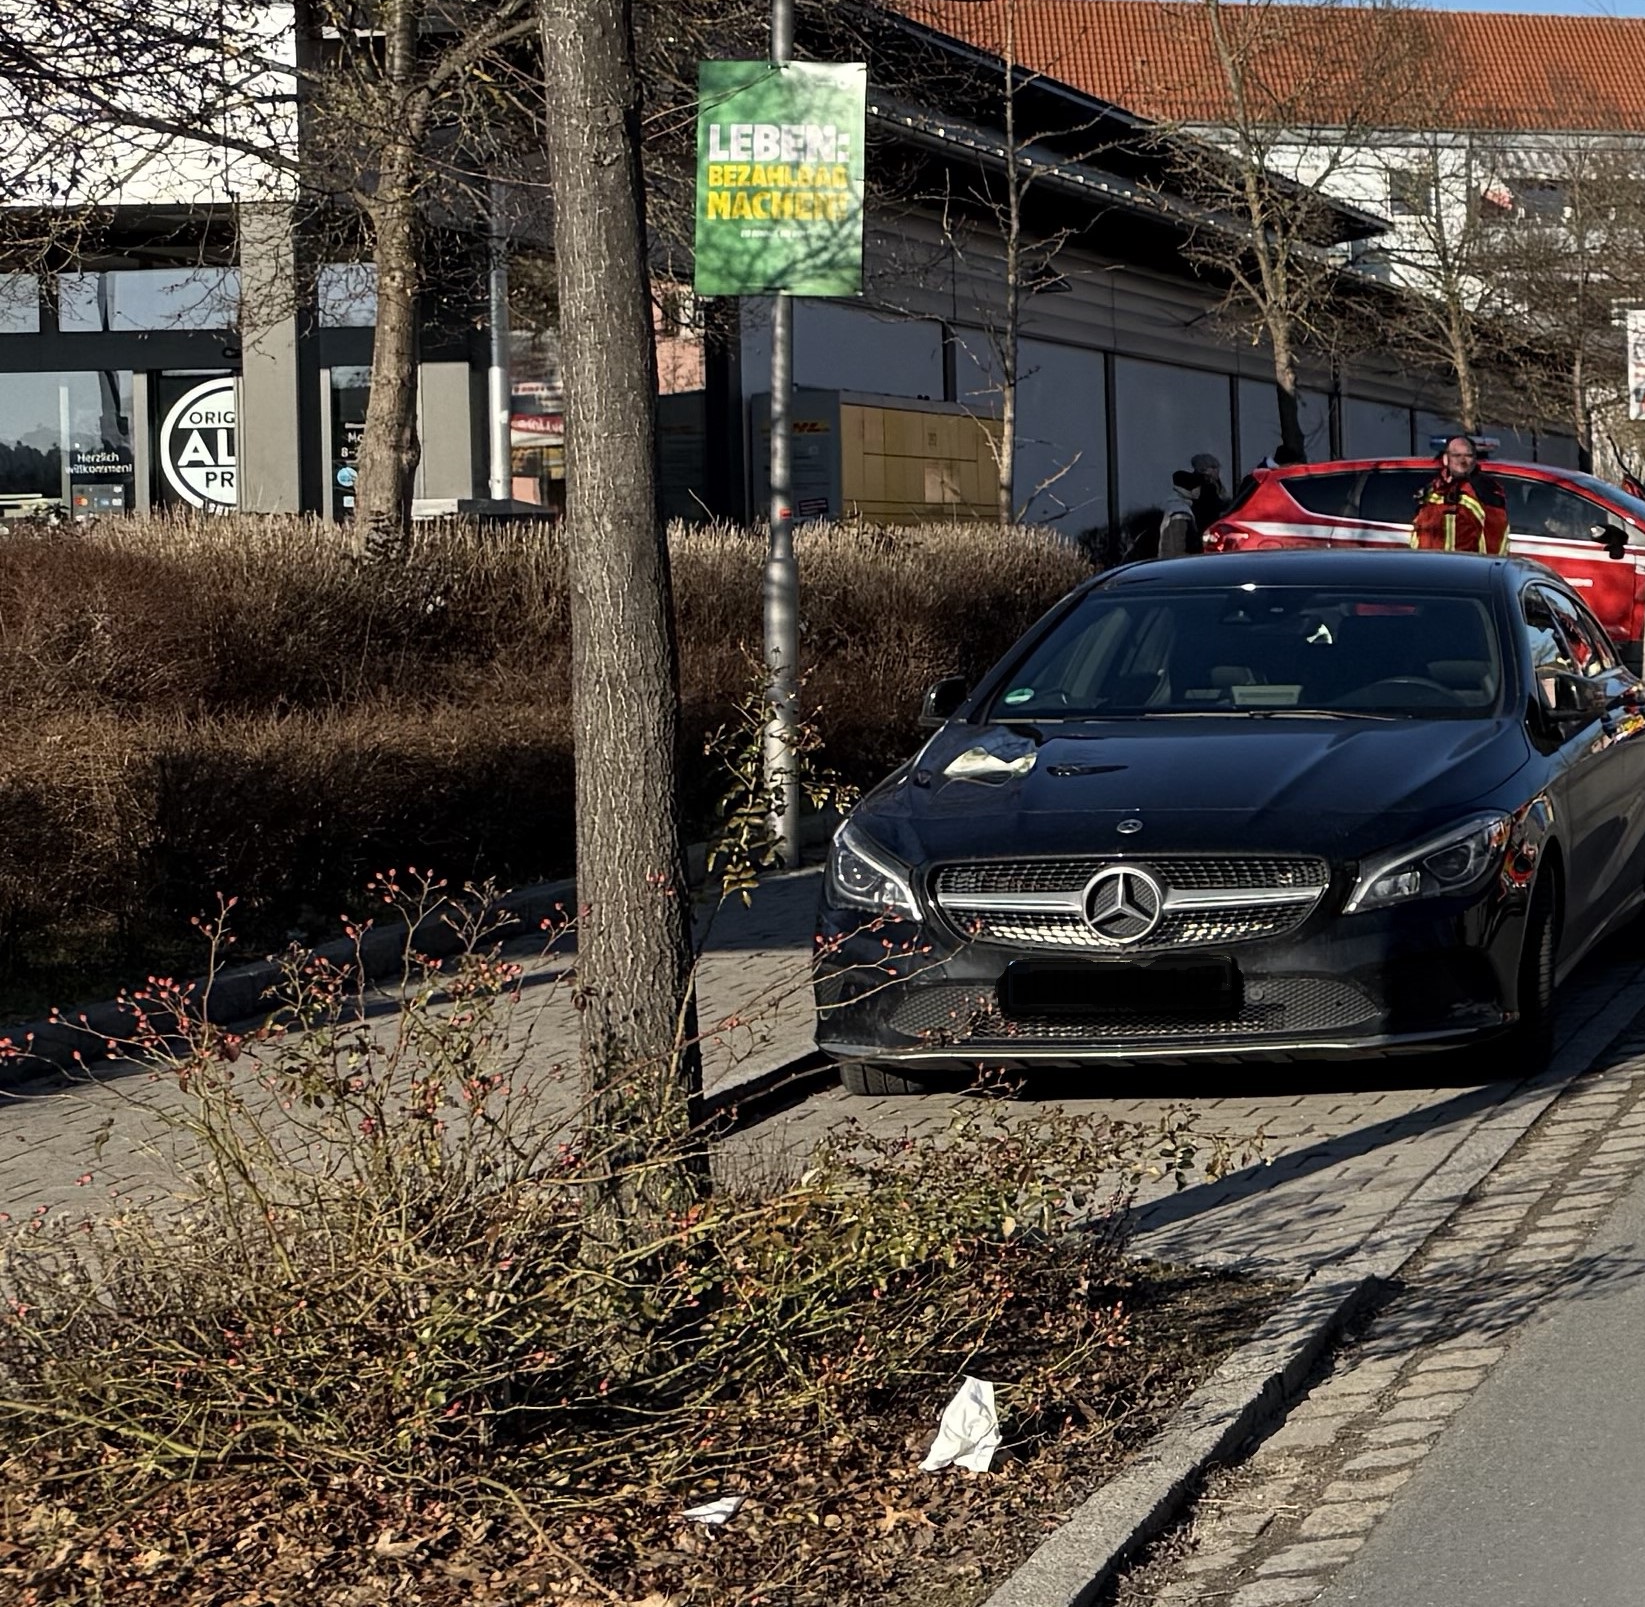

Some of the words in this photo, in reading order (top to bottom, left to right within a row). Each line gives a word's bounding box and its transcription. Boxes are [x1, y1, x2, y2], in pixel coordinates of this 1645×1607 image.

[709, 124, 850, 162] LEBEN:
[708, 165, 848, 188] BEZAHLBAR
[706, 191, 848, 220] MACHEN!
[77, 452, 120, 464] Herzlich
